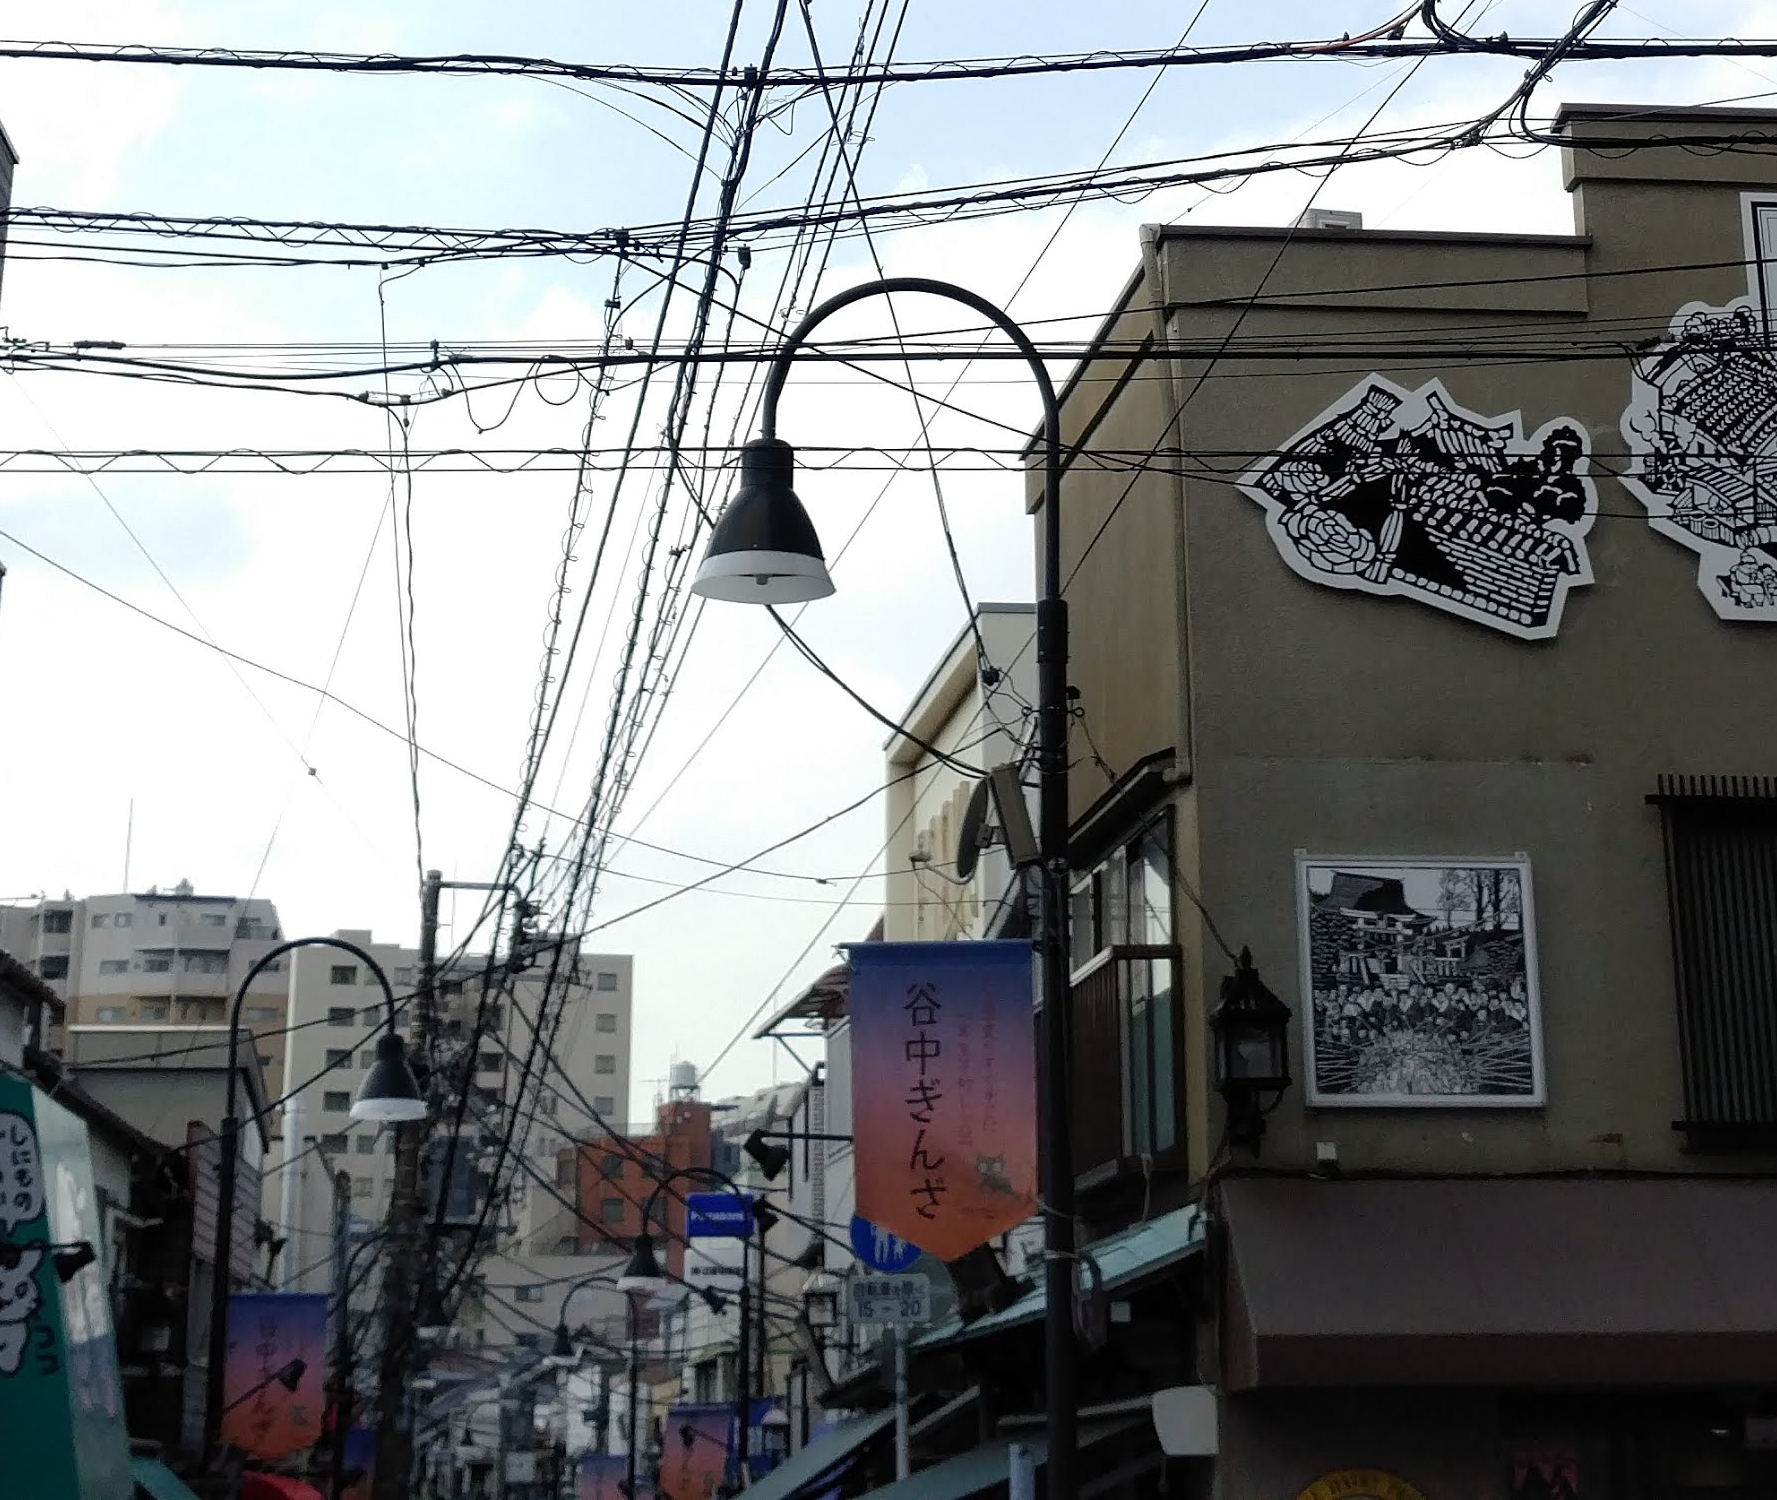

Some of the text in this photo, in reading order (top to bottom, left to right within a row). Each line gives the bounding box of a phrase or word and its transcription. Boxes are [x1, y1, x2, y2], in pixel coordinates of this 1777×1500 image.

[902, 981, 947, 1220] 谷中ぎんざ
